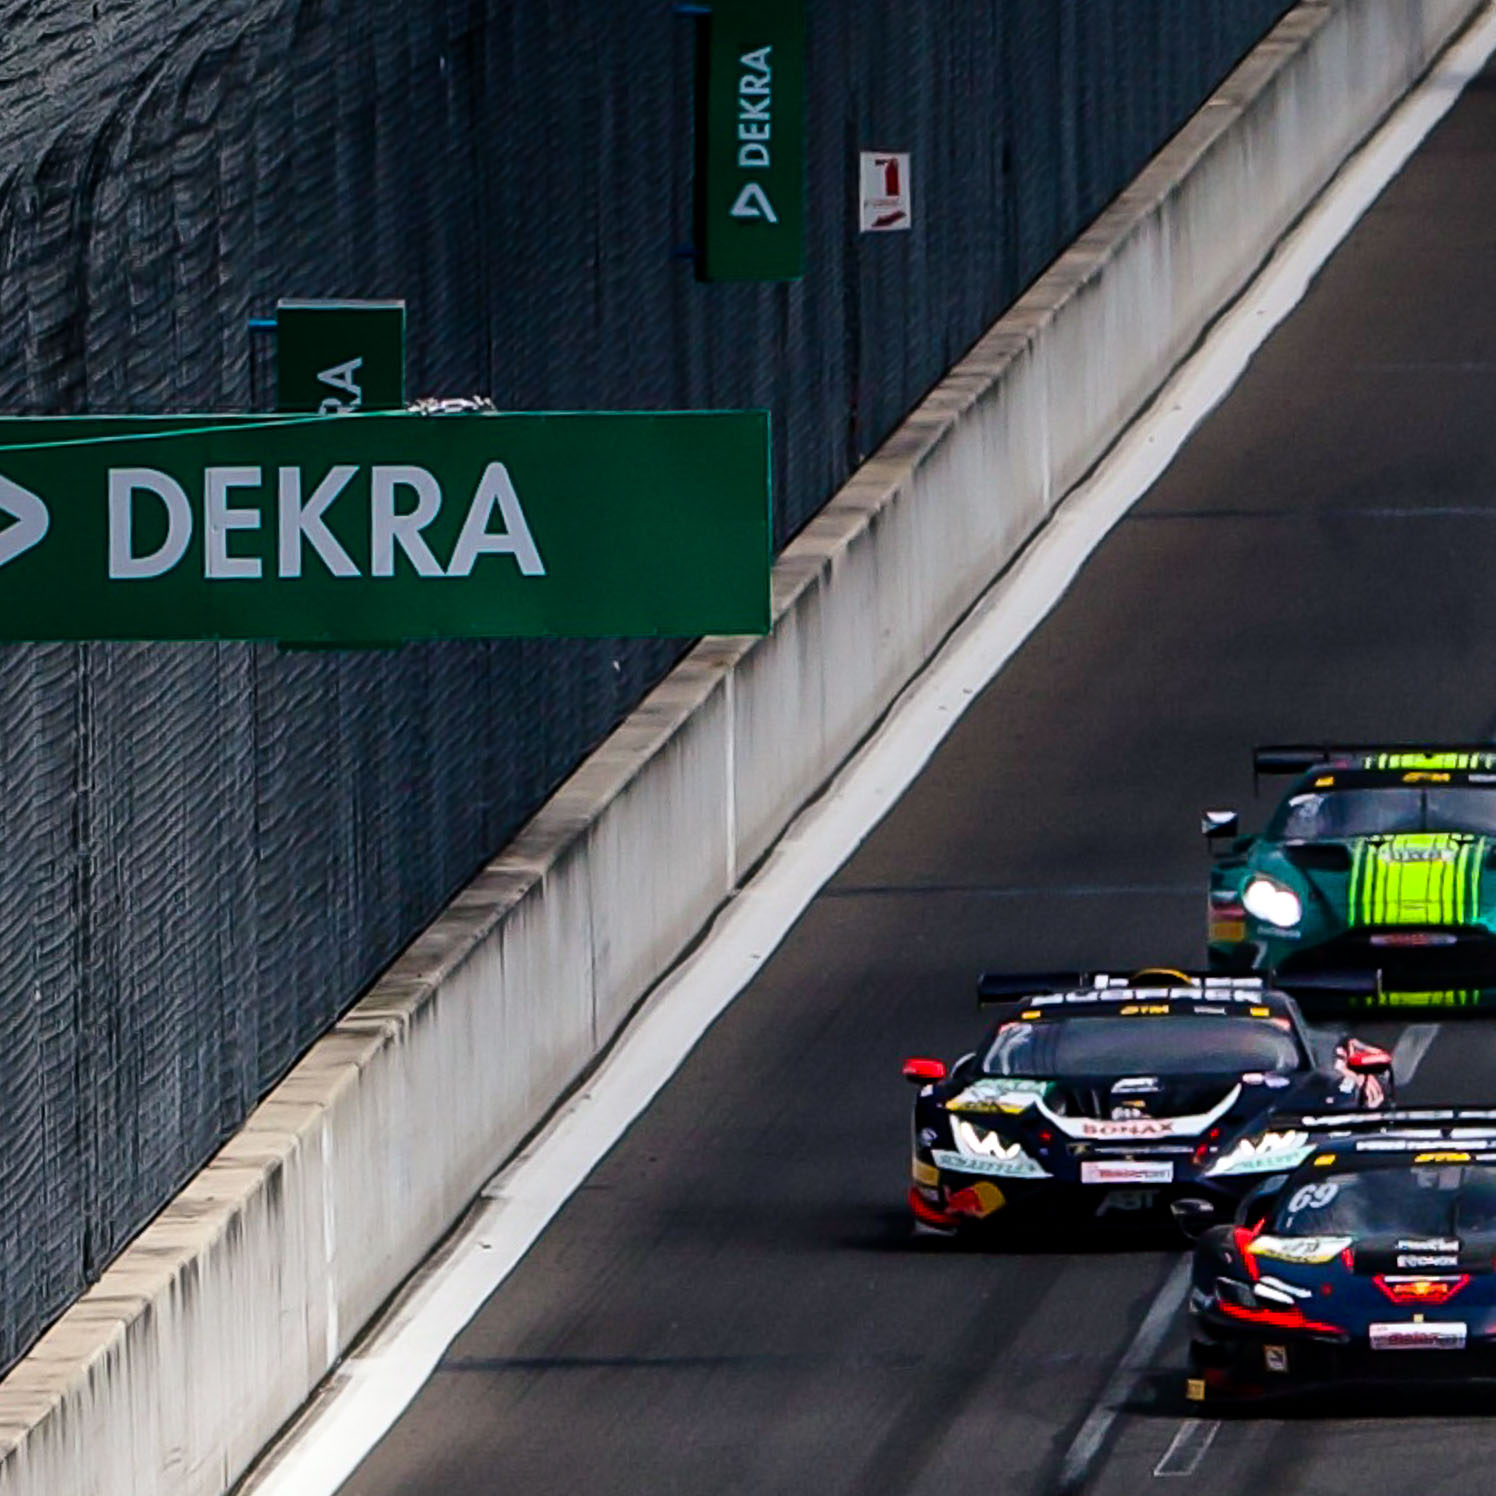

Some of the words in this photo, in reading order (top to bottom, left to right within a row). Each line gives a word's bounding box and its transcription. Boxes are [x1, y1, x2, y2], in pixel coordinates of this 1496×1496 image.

[738, 45, 773, 167] DEKRA
[109, 461, 546, 579] DEKRA
[1285, 1182, 1336, 1213] 69
